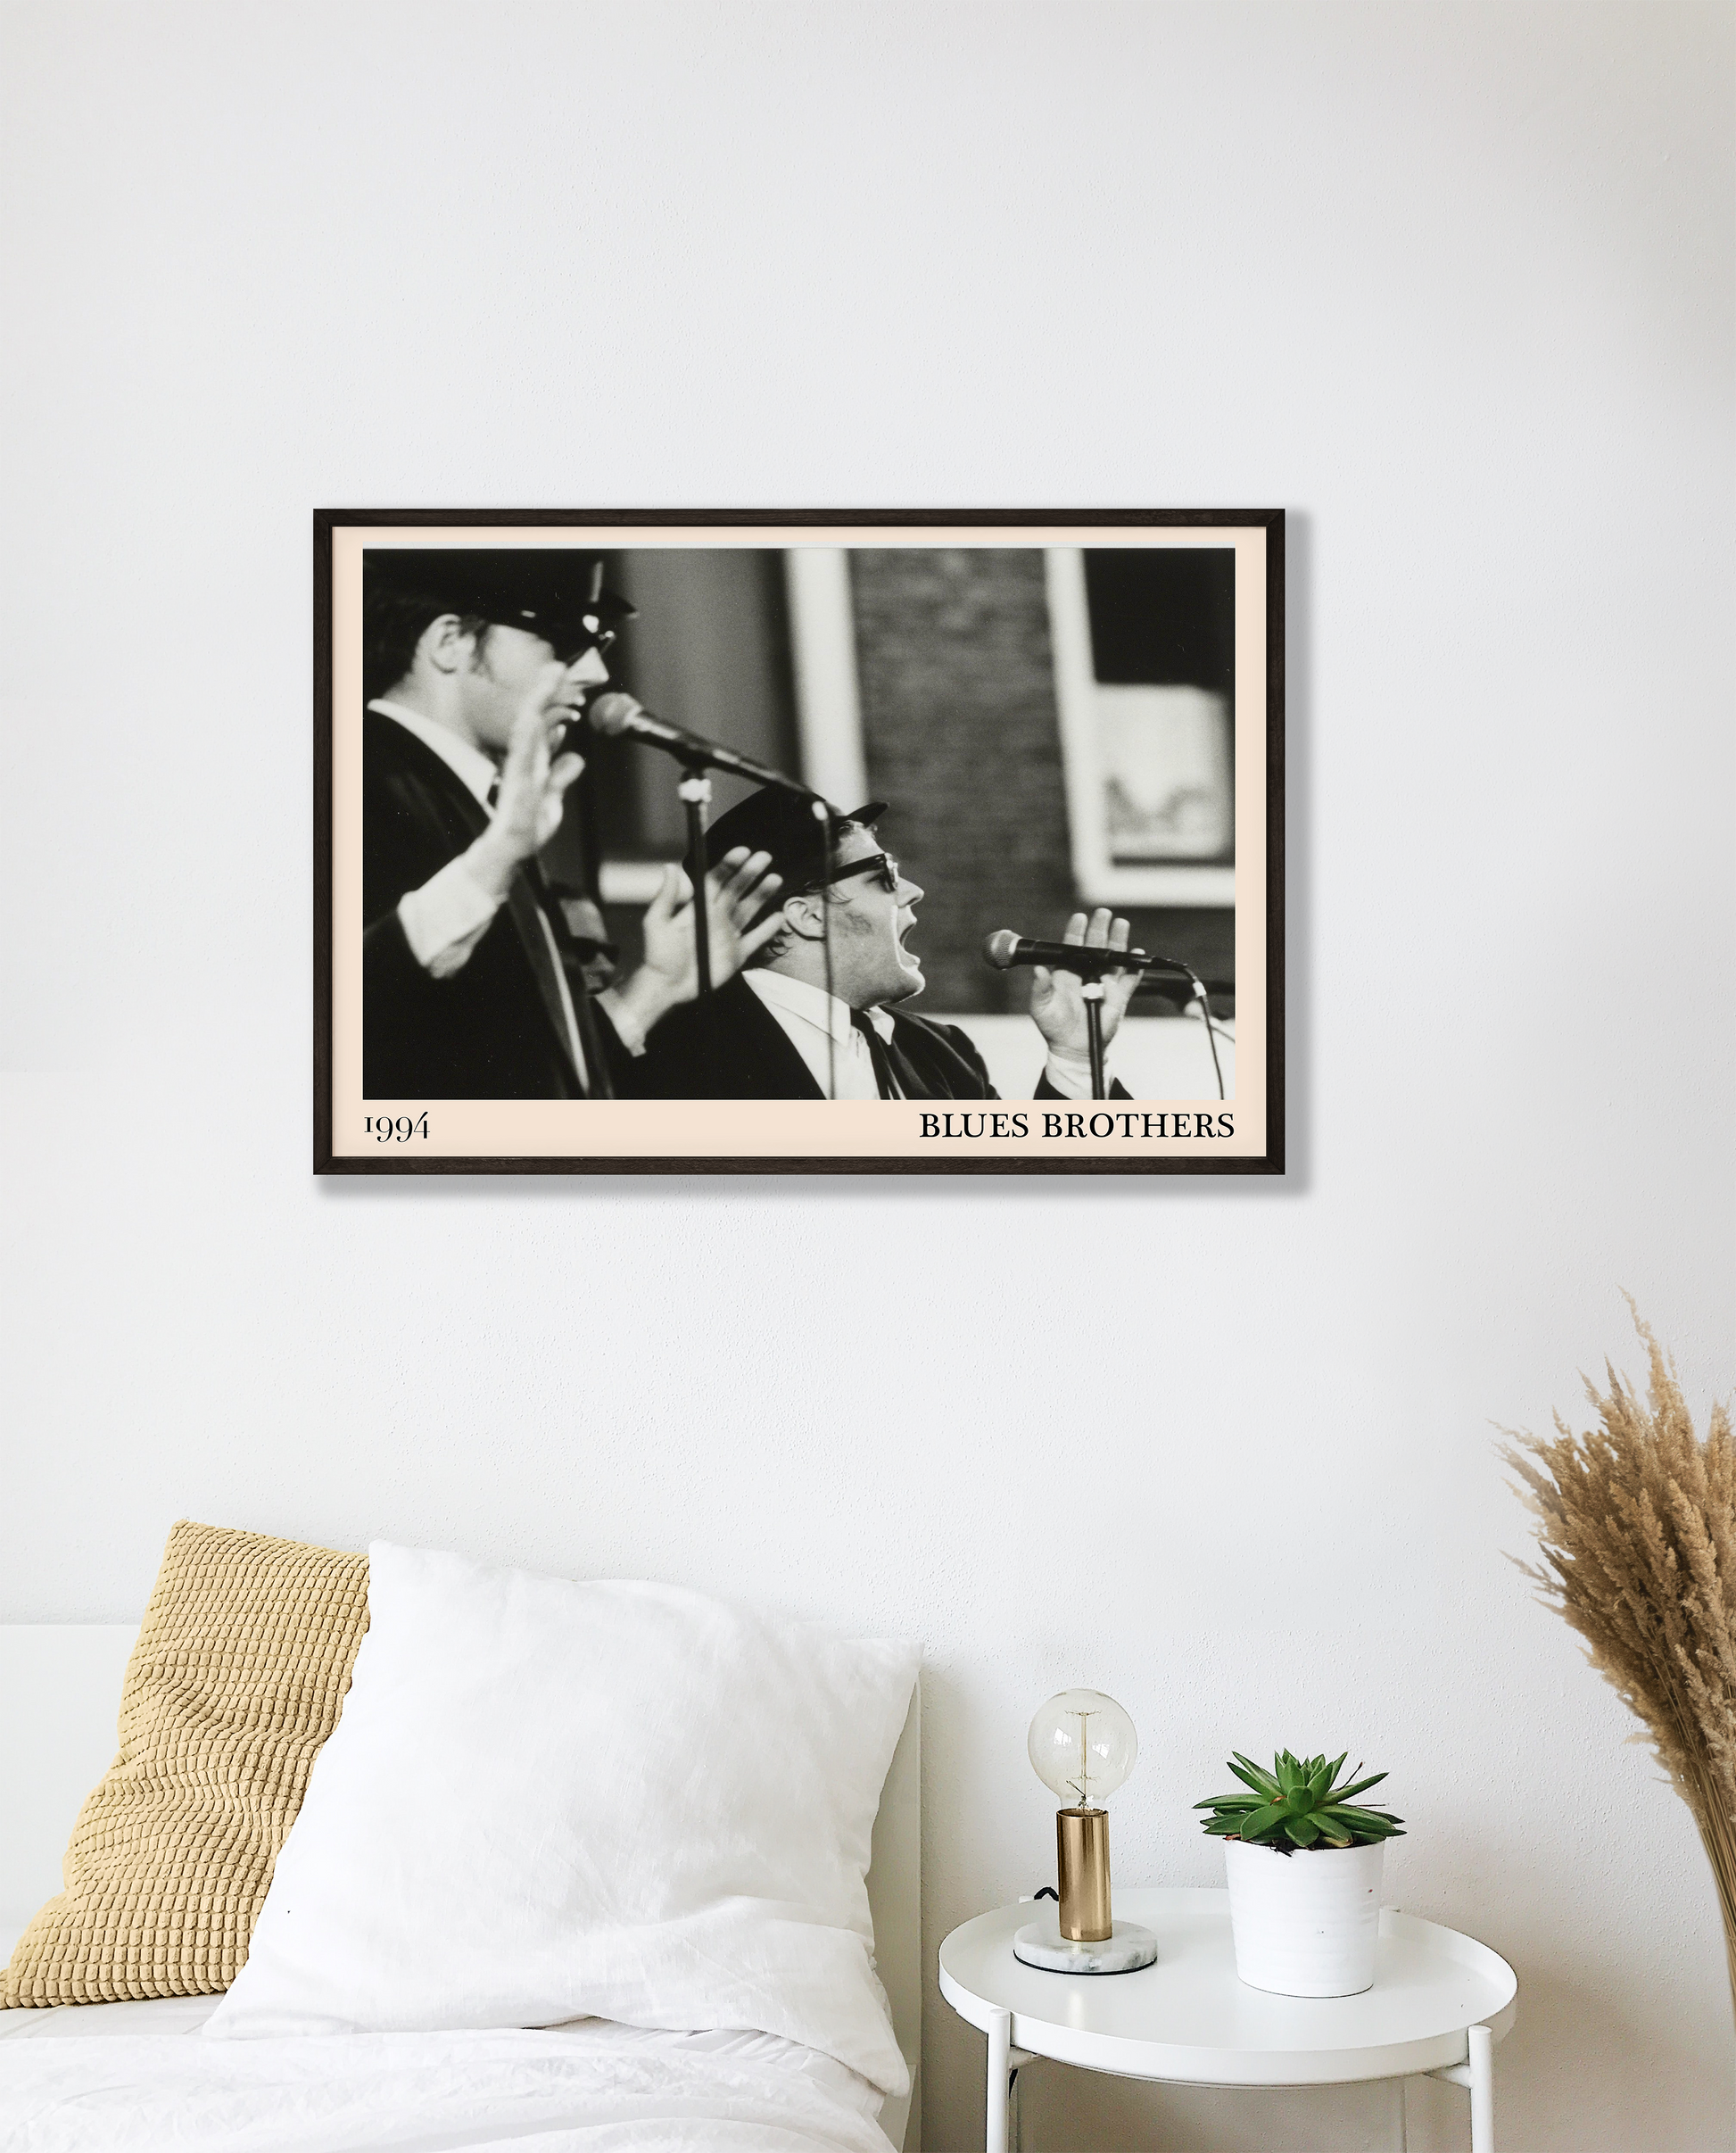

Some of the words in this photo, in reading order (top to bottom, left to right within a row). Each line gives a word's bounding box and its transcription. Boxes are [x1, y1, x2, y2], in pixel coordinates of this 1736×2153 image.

[364, 1111, 430, 1142] 1994
[919, 1113, 1029, 1138] BLUES
[1041, 1113, 1235, 1138] BROTHERS
